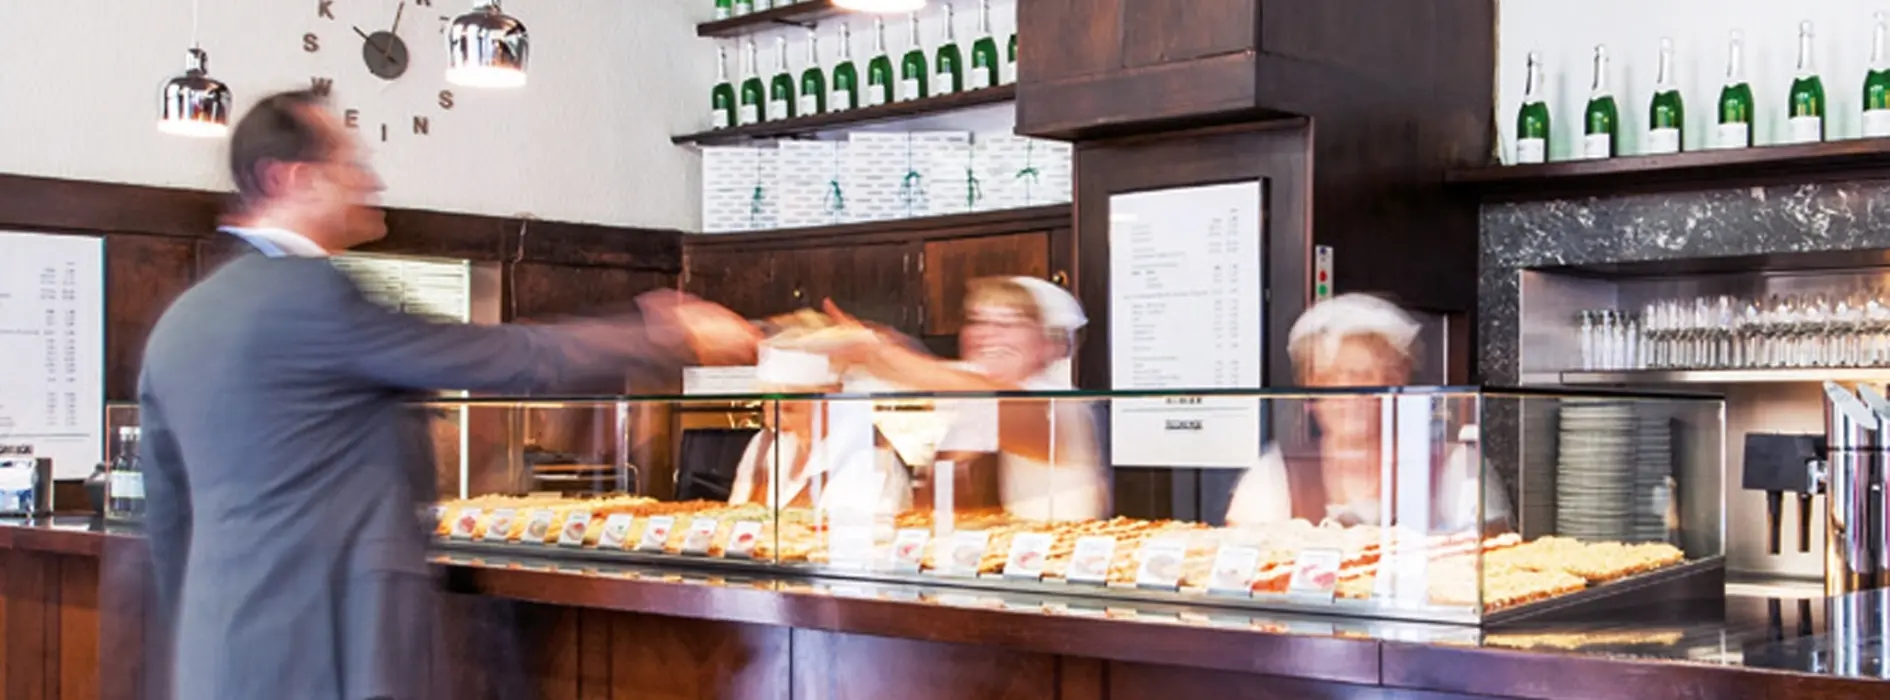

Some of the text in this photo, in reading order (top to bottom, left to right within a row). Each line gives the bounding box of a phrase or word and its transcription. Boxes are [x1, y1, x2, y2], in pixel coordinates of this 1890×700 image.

[318, 0, 335, 20] K
[303, 32, 319, 53] S
[311, 76, 333, 97] W
[438, 89, 454, 110] S
[345, 108, 360, 128] E
[413, 115, 429, 135] N
[381, 123, 387, 142] I
